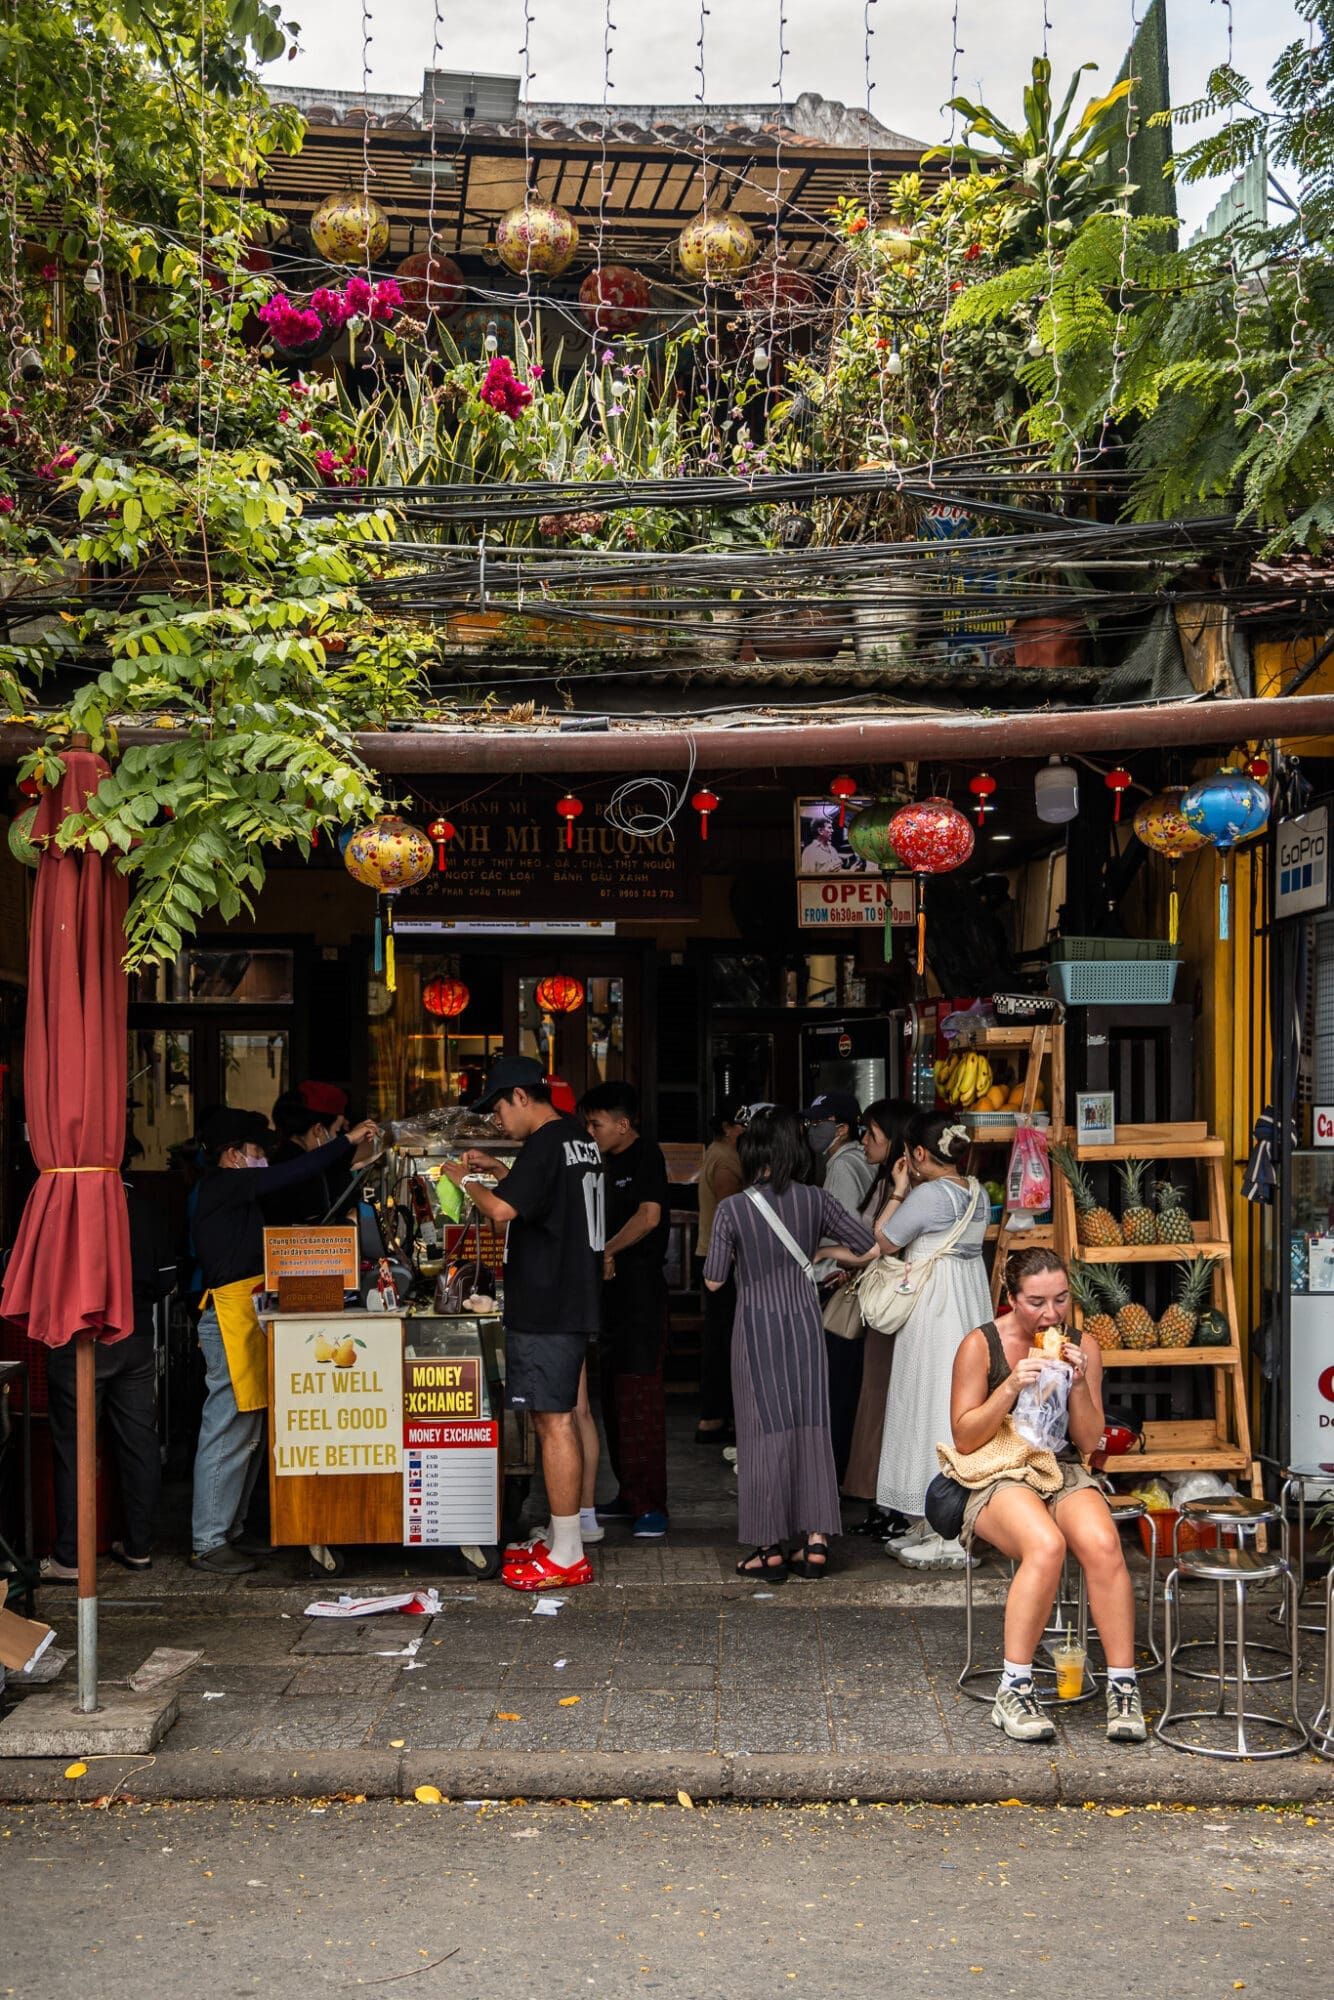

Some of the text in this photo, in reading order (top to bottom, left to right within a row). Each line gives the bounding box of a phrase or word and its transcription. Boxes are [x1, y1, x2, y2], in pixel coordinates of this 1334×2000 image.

[504, 817, 542, 853] MÌ
[1281, 836, 1324, 867] GoPro
[821, 884, 891, 903] OPEN
[804, 908, 828, 922] FROM
[830, 908, 863, 922] 6h30am
[864, 907, 875, 921] TO
[290, 1372, 383, 1394] EAT WELL
[413, 1366, 462, 1387] MONEY
[287, 1408, 387, 1431] FEEL GOOD
[409, 1428, 492, 1442] MONEY EXCHANGE
[279, 1444, 397, 1468] LIVE BETTER
